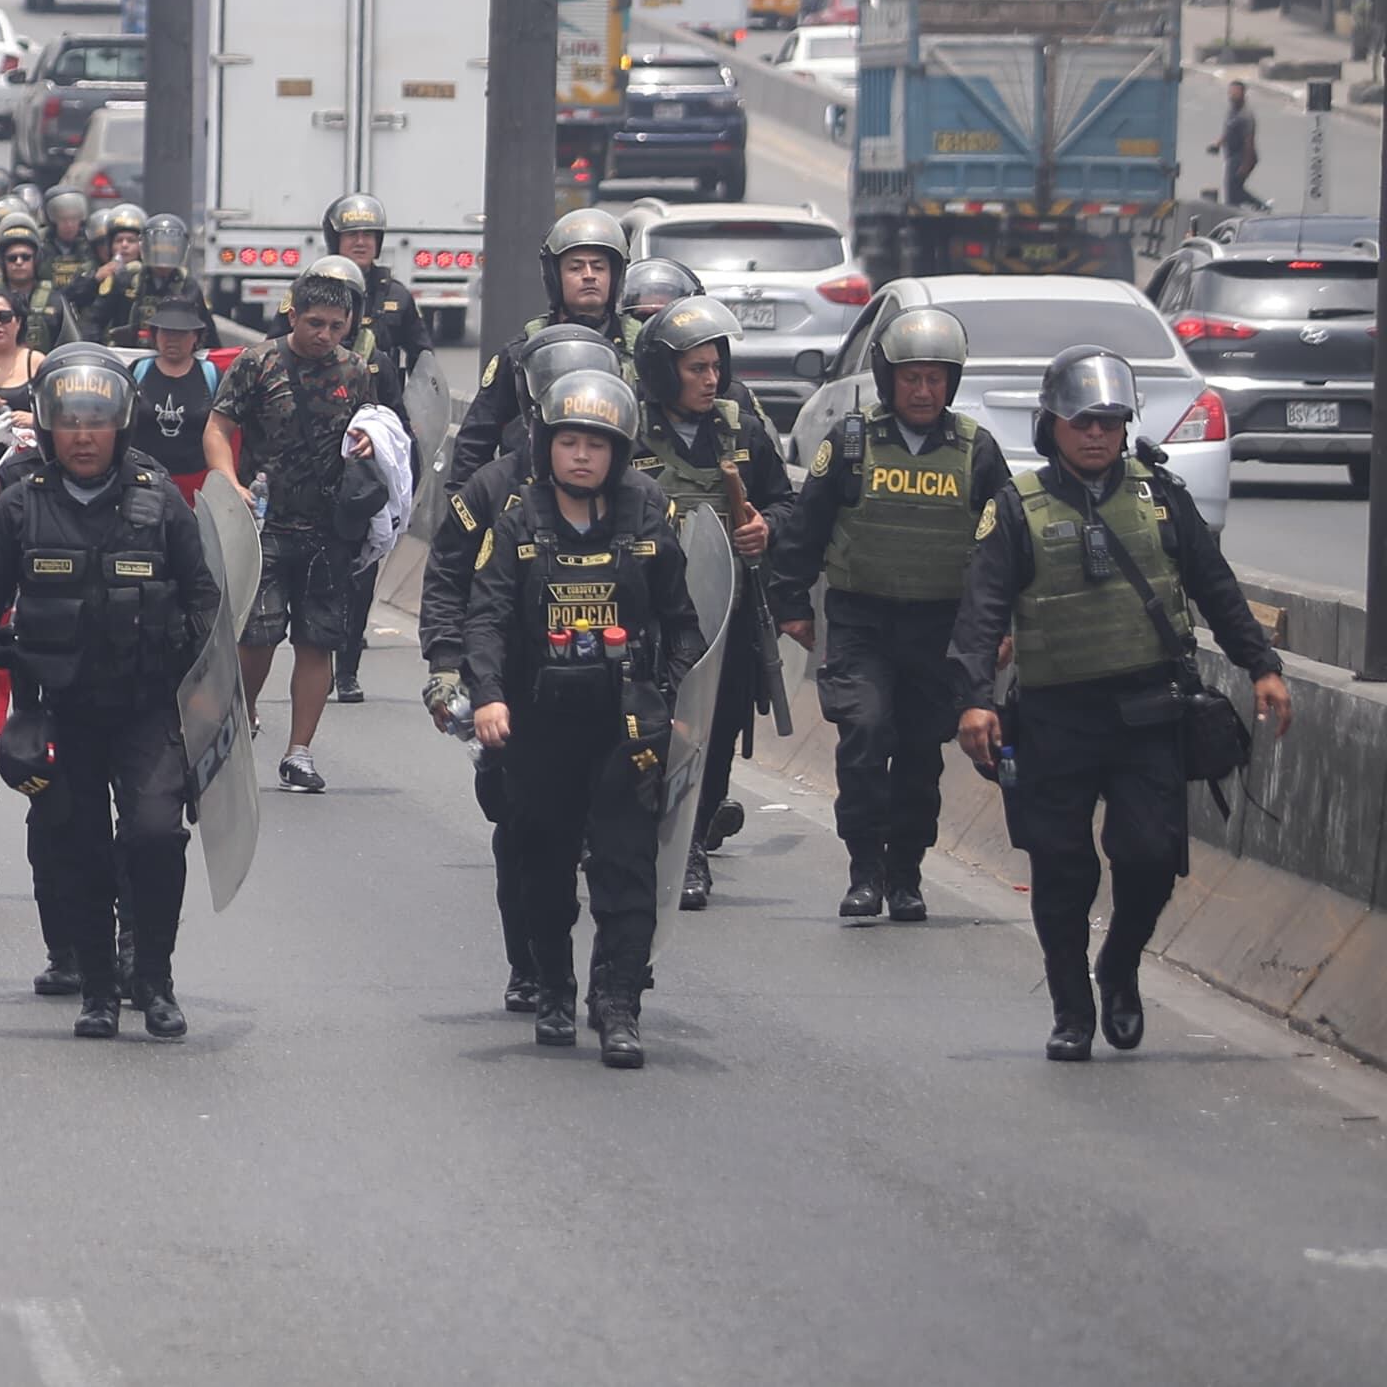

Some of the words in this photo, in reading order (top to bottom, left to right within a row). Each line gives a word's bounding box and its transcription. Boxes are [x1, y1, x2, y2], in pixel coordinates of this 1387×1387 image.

[340, 210, 376, 223] POLICIA
[55, 377, 113, 400] POLICIA
[563, 396, 619, 427] POLICIA
[872, 467, 959, 498] POLICIA
[551, 604, 615, 627] POLICIA
